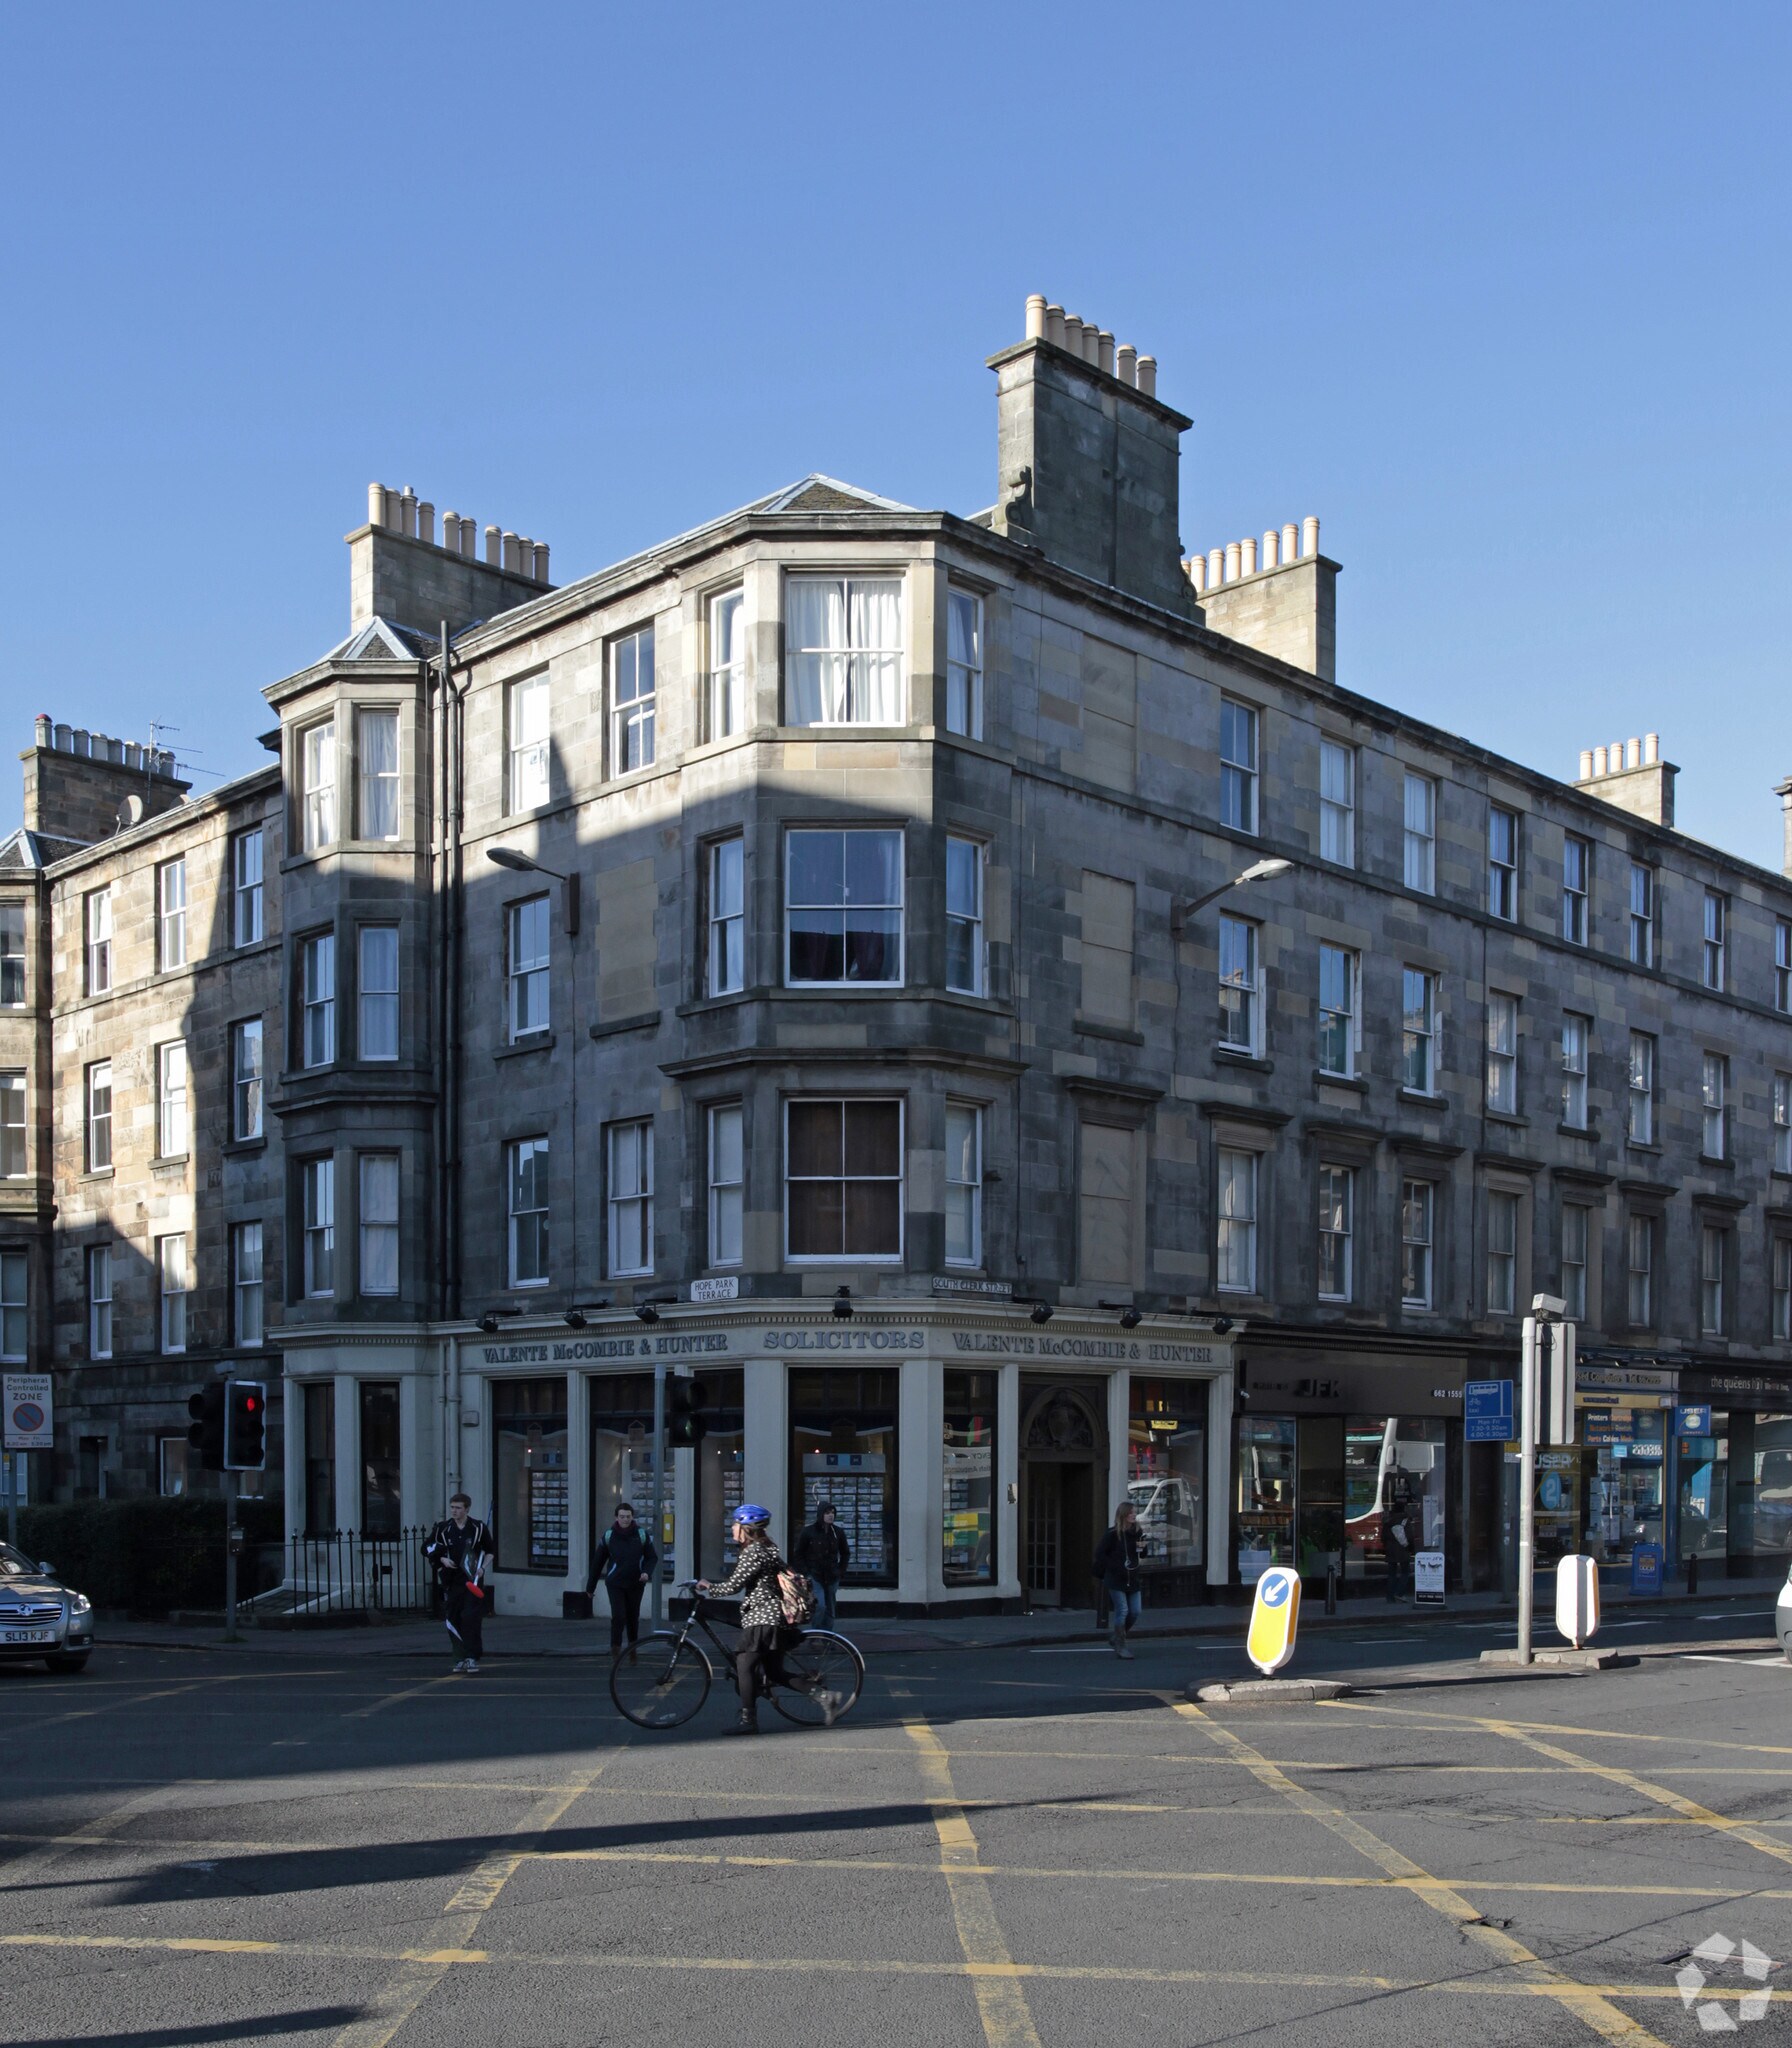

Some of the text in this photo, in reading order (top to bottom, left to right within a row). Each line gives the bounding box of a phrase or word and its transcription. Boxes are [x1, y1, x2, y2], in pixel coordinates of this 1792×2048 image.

[694, 1278, 734, 1291] HOPE PARK
[932, 1277, 1012, 1295] SOUTH CLERK STREET
[697, 1288, 732, 1300] TERRACE
[763, 1330, 925, 1350] SOLICITORS
[483, 1333, 728, 1363] VALENTE McCOMBIE & HUNTER
[952, 1332, 1213, 1364] VALENTE McCOMBIE & HUNTER
[1302, 1378, 1342, 1398] JFK
[1710, 1375, 1723, 1388] the
[1433, 1389, 1463, 1399] 662 1555
[1587, 1413, 1609, 1422] Printers
[1680, 1407, 1707, 1415] USER
[1602, 1434, 1619, 1443] Cables
[1545, 1478, 1558, 1502] 2
[5, 1631, 49, 1642] SL13 KJF
